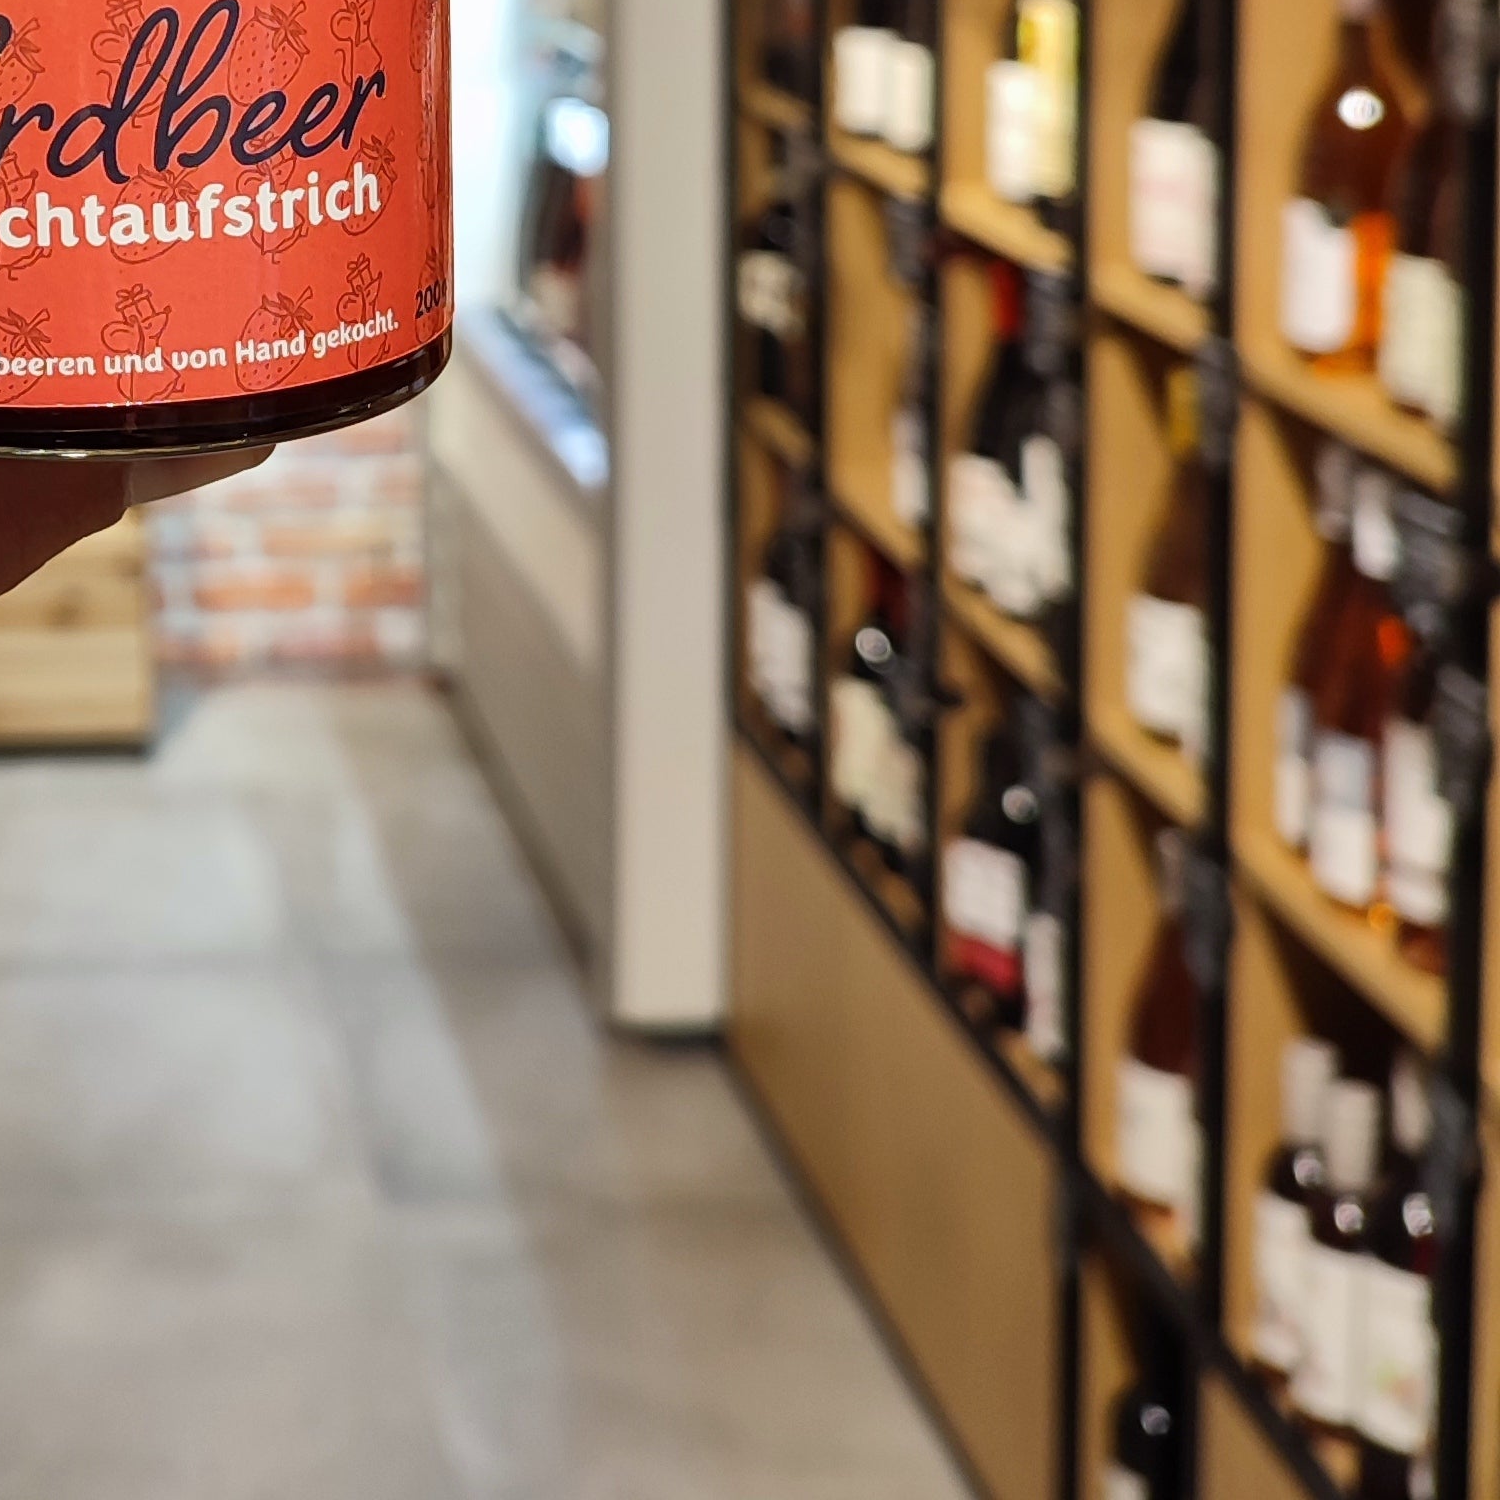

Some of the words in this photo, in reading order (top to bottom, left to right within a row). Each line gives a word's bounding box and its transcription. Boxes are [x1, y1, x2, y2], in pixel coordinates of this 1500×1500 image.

[104, 347, 162, 376] und
[171, 350, 227, 372] von
[235, 330, 306, 366] Hand
[312, 307, 399, 361] gekocht.
